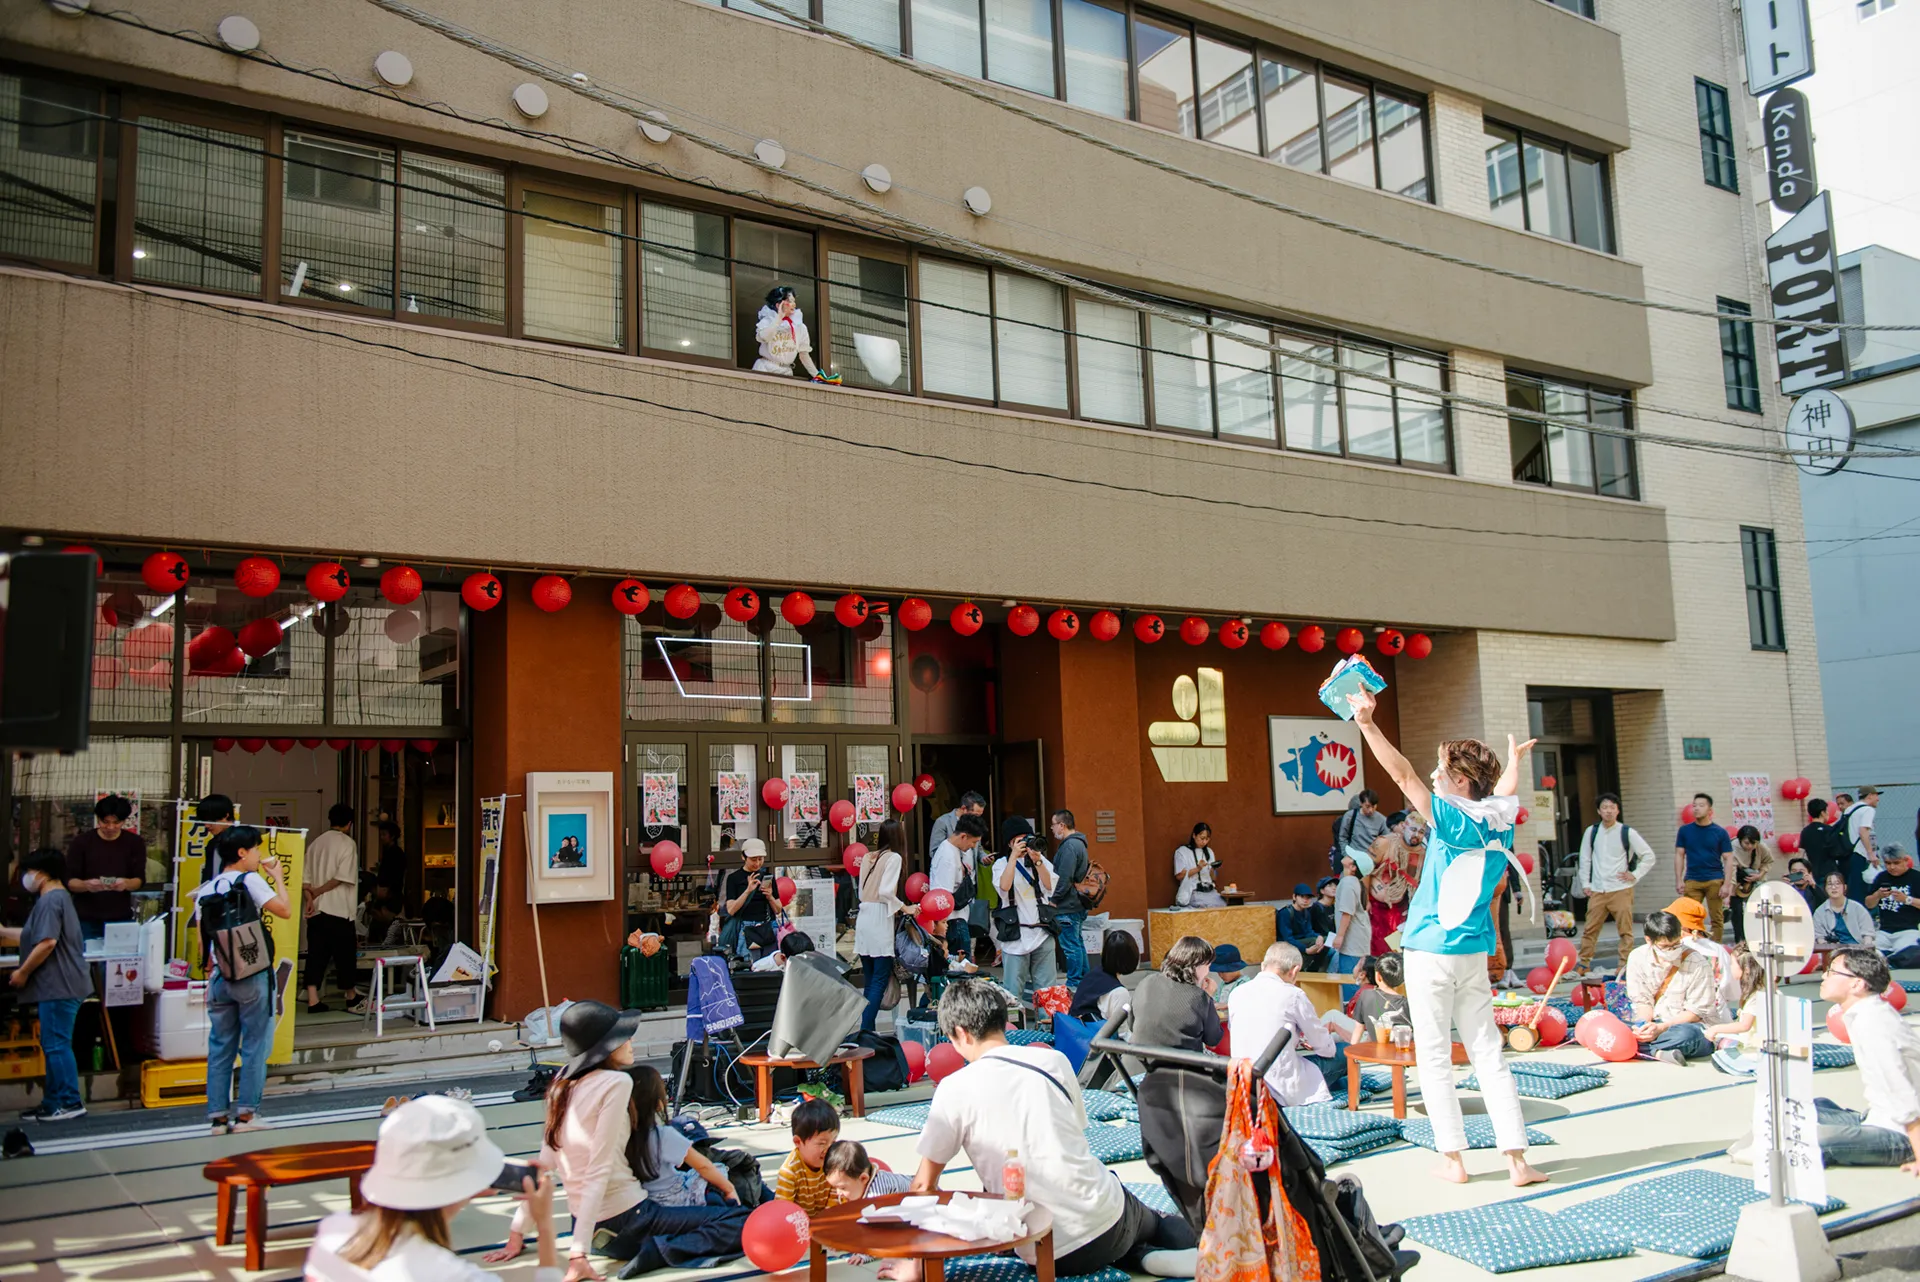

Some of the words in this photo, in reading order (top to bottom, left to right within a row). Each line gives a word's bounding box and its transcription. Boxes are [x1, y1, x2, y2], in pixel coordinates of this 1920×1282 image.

[1771, 103, 1804, 198] Kanda
[1767, 229, 1845, 379] PORT
[1801, 399, 1834, 466] 神田
